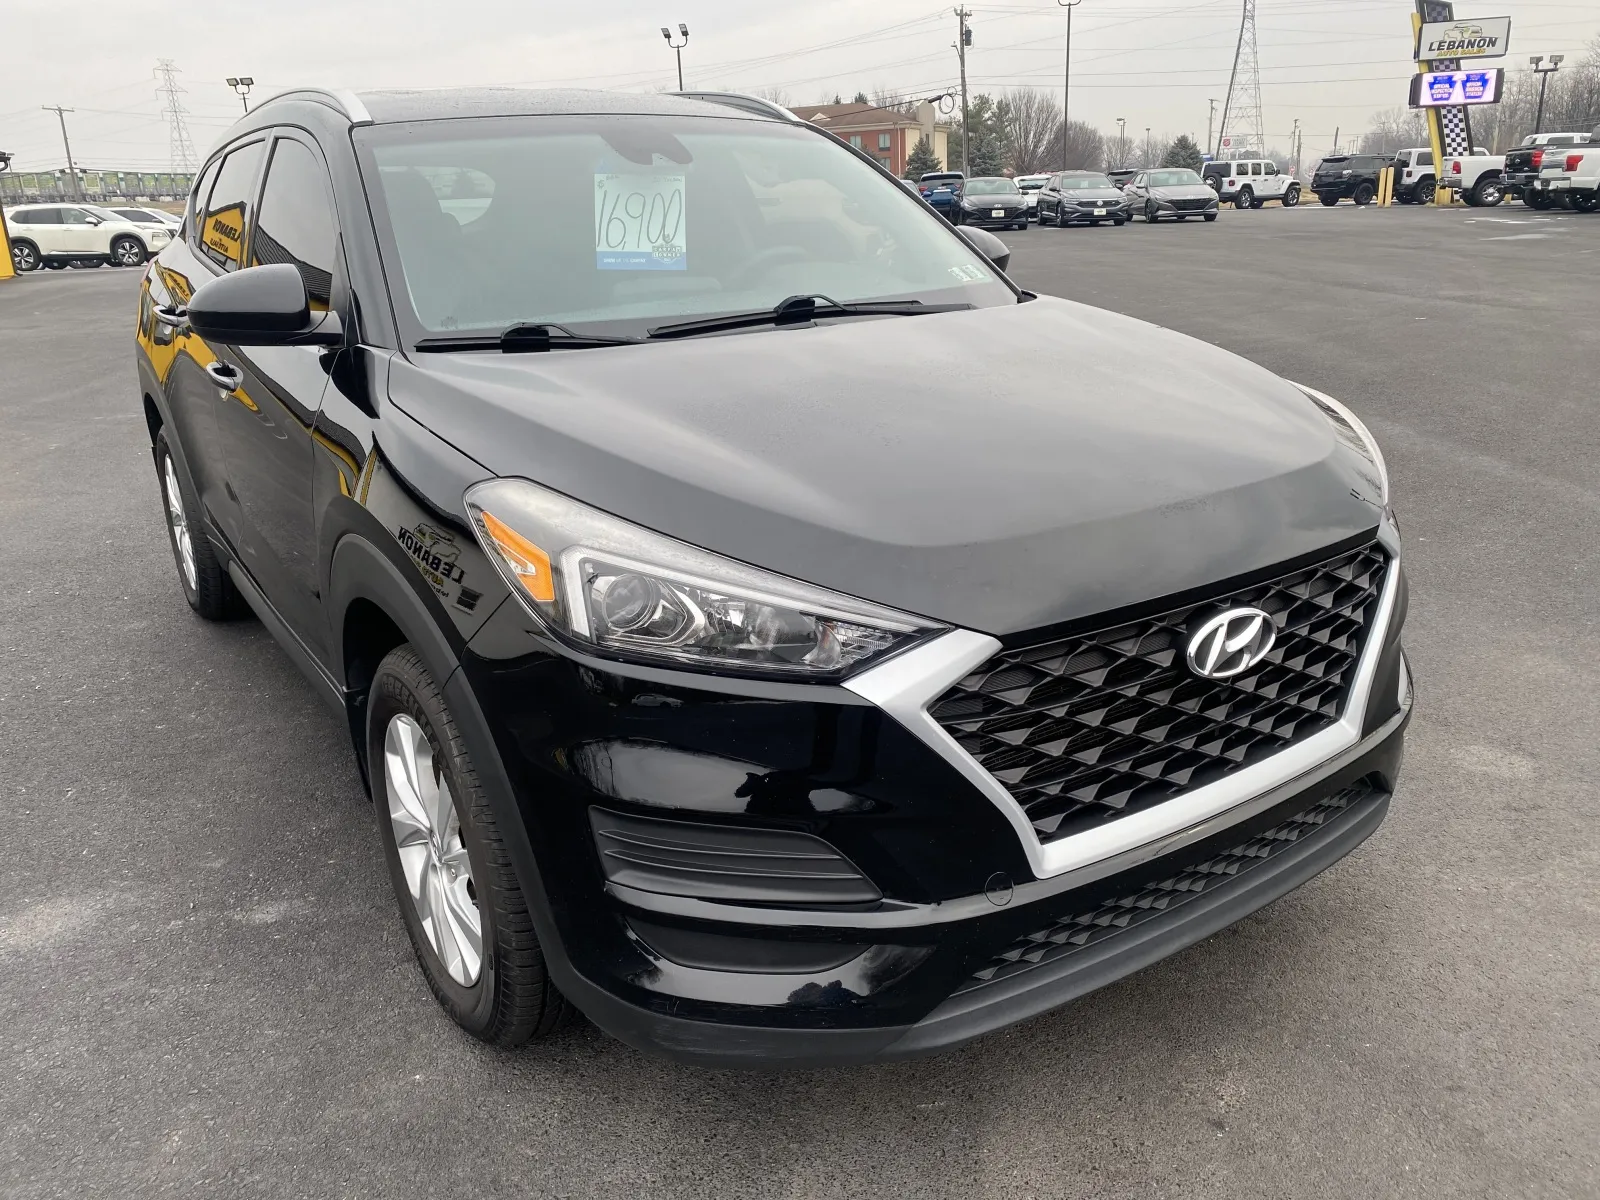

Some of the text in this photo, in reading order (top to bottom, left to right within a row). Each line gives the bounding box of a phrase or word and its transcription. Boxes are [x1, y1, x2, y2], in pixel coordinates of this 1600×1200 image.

[1428, 37, 1498, 51] LEBANON
[1436, 48, 1486, 57] AUTO SALES
[597, 189, 682, 250] 16,900
